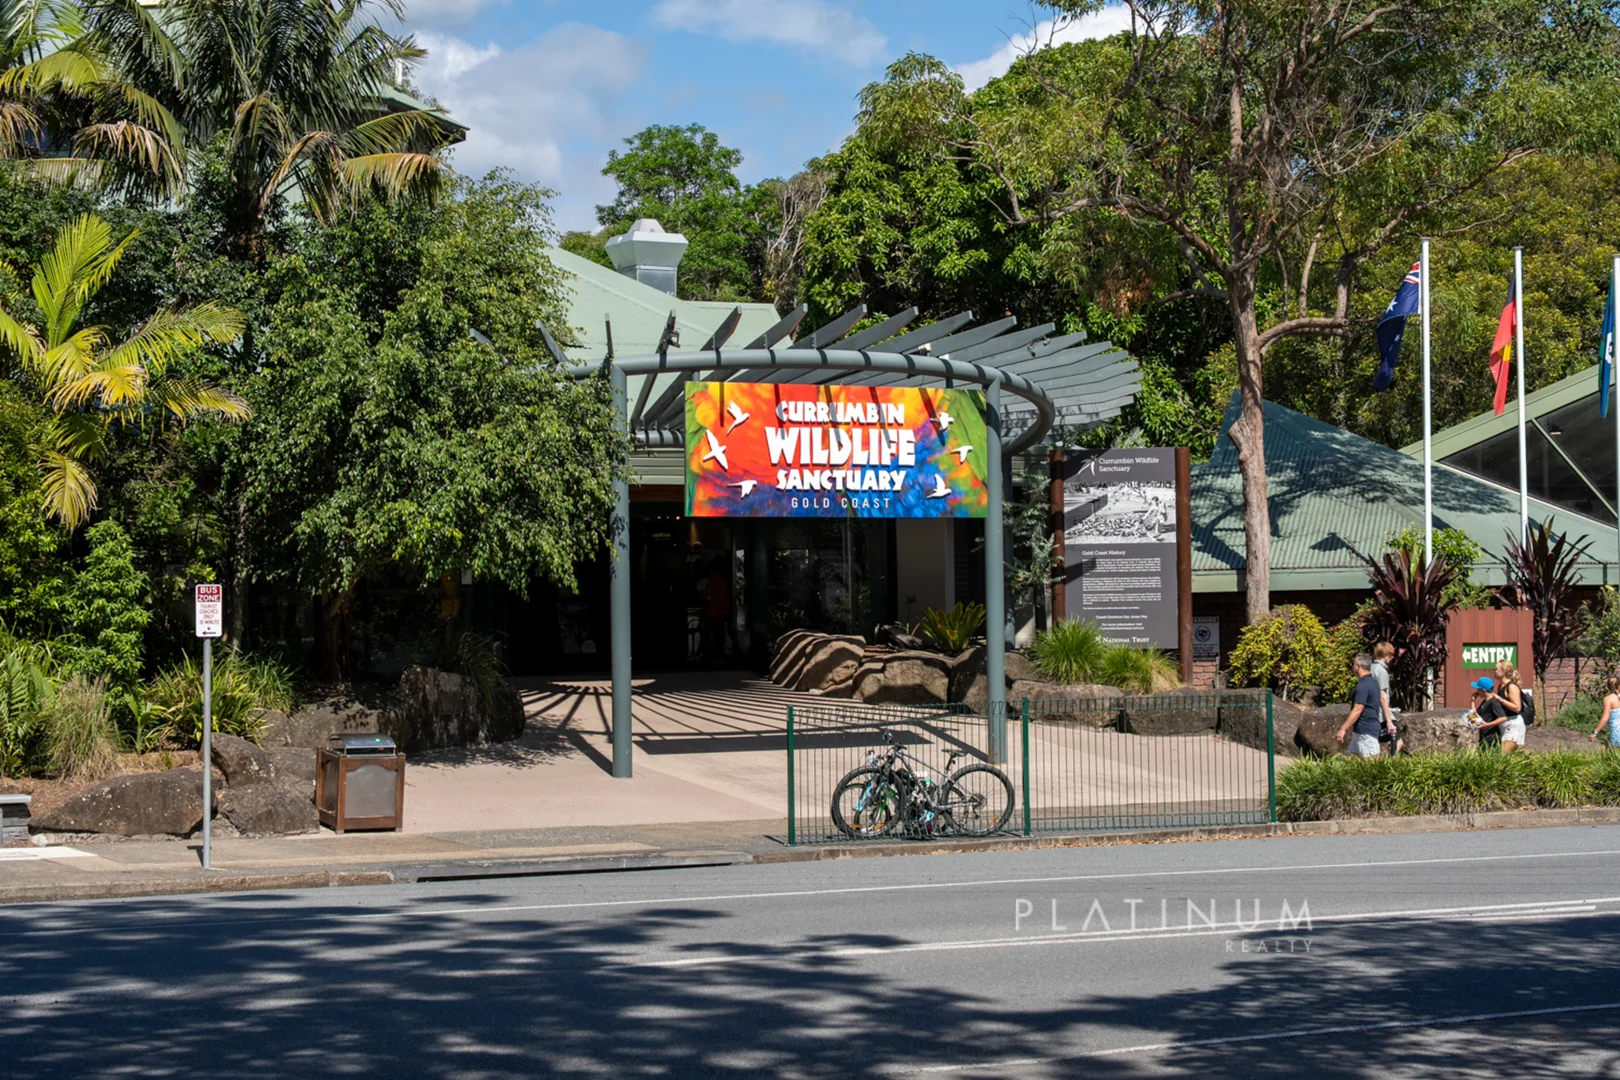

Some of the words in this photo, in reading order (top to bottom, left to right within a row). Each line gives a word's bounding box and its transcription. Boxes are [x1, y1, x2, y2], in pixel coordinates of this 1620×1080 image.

[776, 400, 905, 424] CURRUMBIN
[764, 426, 916, 467] WILDLIFE
[1098, 457, 1134, 465] Currumbin
[775, 469, 906, 492] SANCTUARY
[791, 497, 830, 509] GOLD
[841, 497, 890, 509] COAST
[200, 586, 218, 594] BUS
[198, 594, 220, 602] ZONE
[1471, 647, 1513, 663] ENTRY
